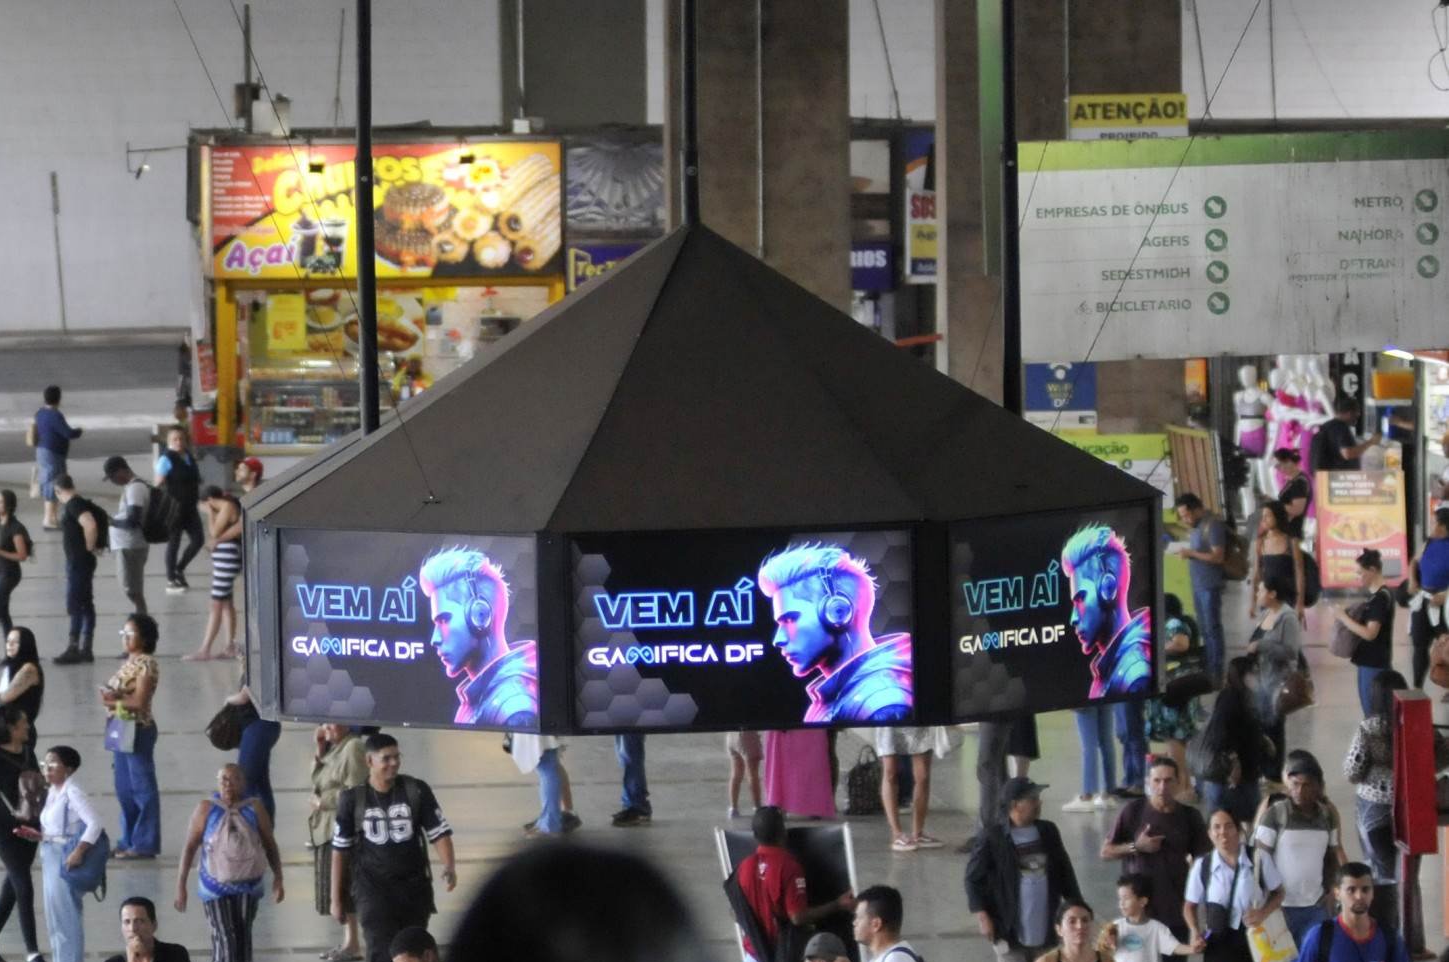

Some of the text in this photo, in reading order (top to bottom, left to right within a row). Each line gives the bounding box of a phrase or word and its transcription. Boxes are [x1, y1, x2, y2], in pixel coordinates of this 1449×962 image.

[1073, 97, 1185, 123] ATENÇÃO!
[1036, 201, 1189, 219] EMPRESAS DE ÔNIBUS
[1141, 235, 1190, 247] AGEFIS
[963, 559, 1060, 615] VEM AÍ
[296, 575, 416, 622] VEM AÍ
[594, 577, 755, 628] VEM AÍ
[1041, 624, 1065, 644] DF
[395, 641, 425, 659] DF
[725, 643, 764, 663] DF
